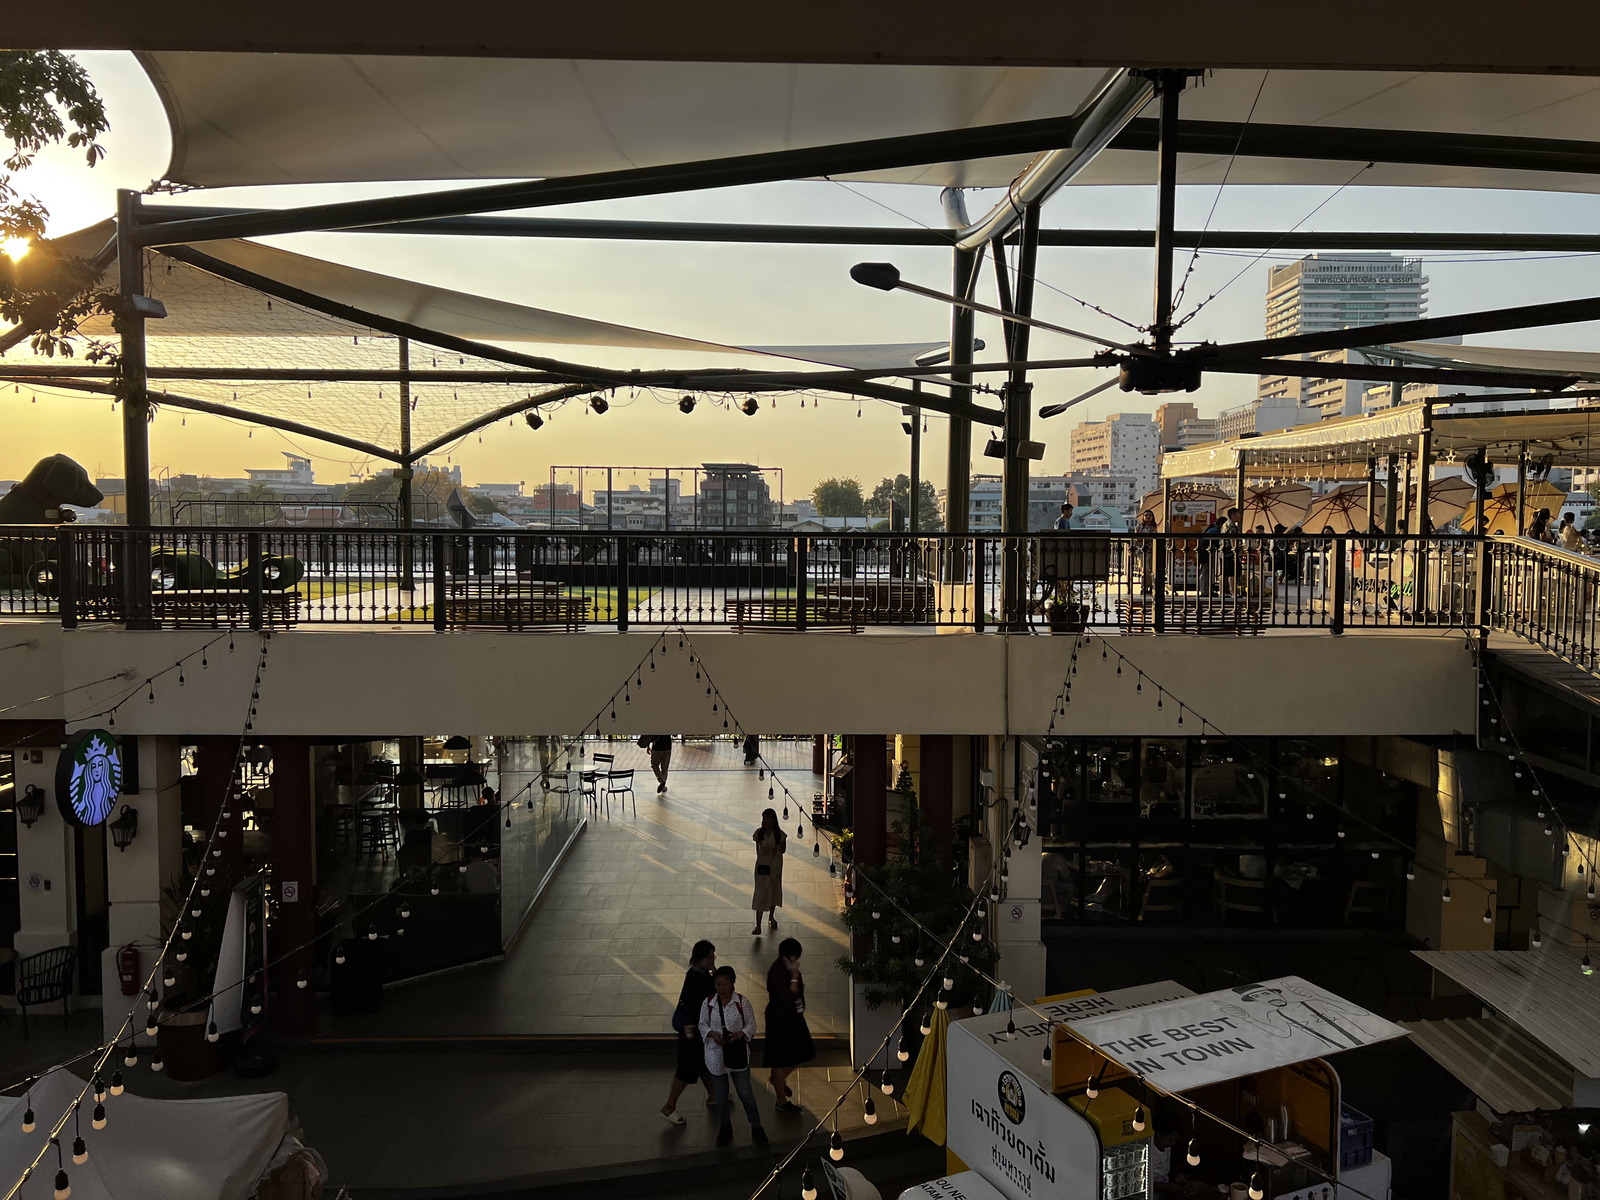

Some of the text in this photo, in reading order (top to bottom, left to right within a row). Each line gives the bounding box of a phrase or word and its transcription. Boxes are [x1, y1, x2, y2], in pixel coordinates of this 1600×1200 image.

[1044, 997, 1114, 1017] HERE
[1098, 1016, 1239, 1055] THE BEST
[1126, 1037, 1256, 1076] IN TOWN
